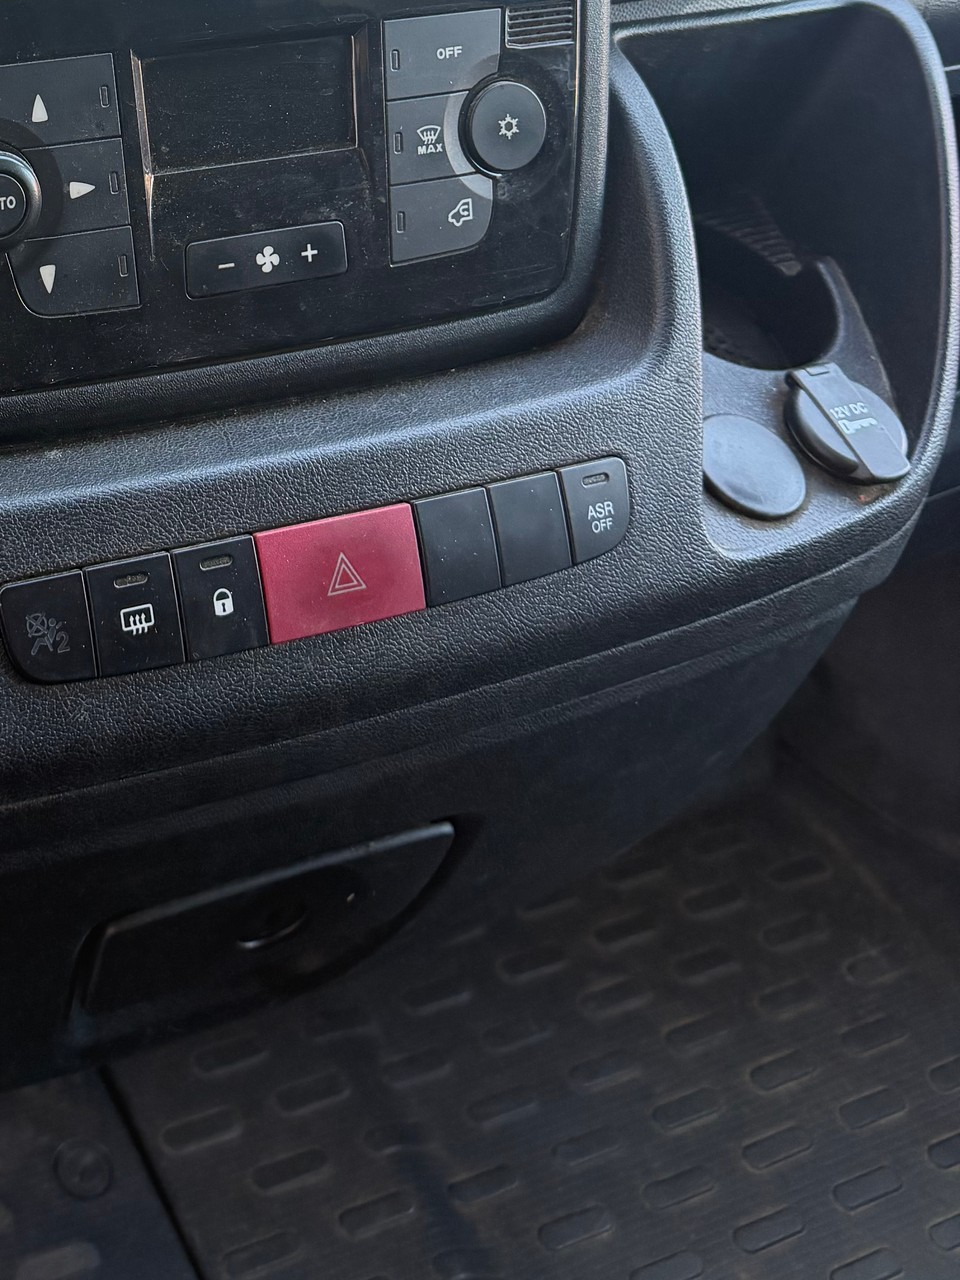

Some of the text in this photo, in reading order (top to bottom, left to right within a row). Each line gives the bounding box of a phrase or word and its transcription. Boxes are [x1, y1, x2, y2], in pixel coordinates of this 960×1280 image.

[436, 45, 463, 60] OFF
[417, 143, 443, 155] MAX
[830, 402, 868, 419] 12V DC
[588, 501, 614, 520] ASR
[591, 517, 613, 533] OFF
